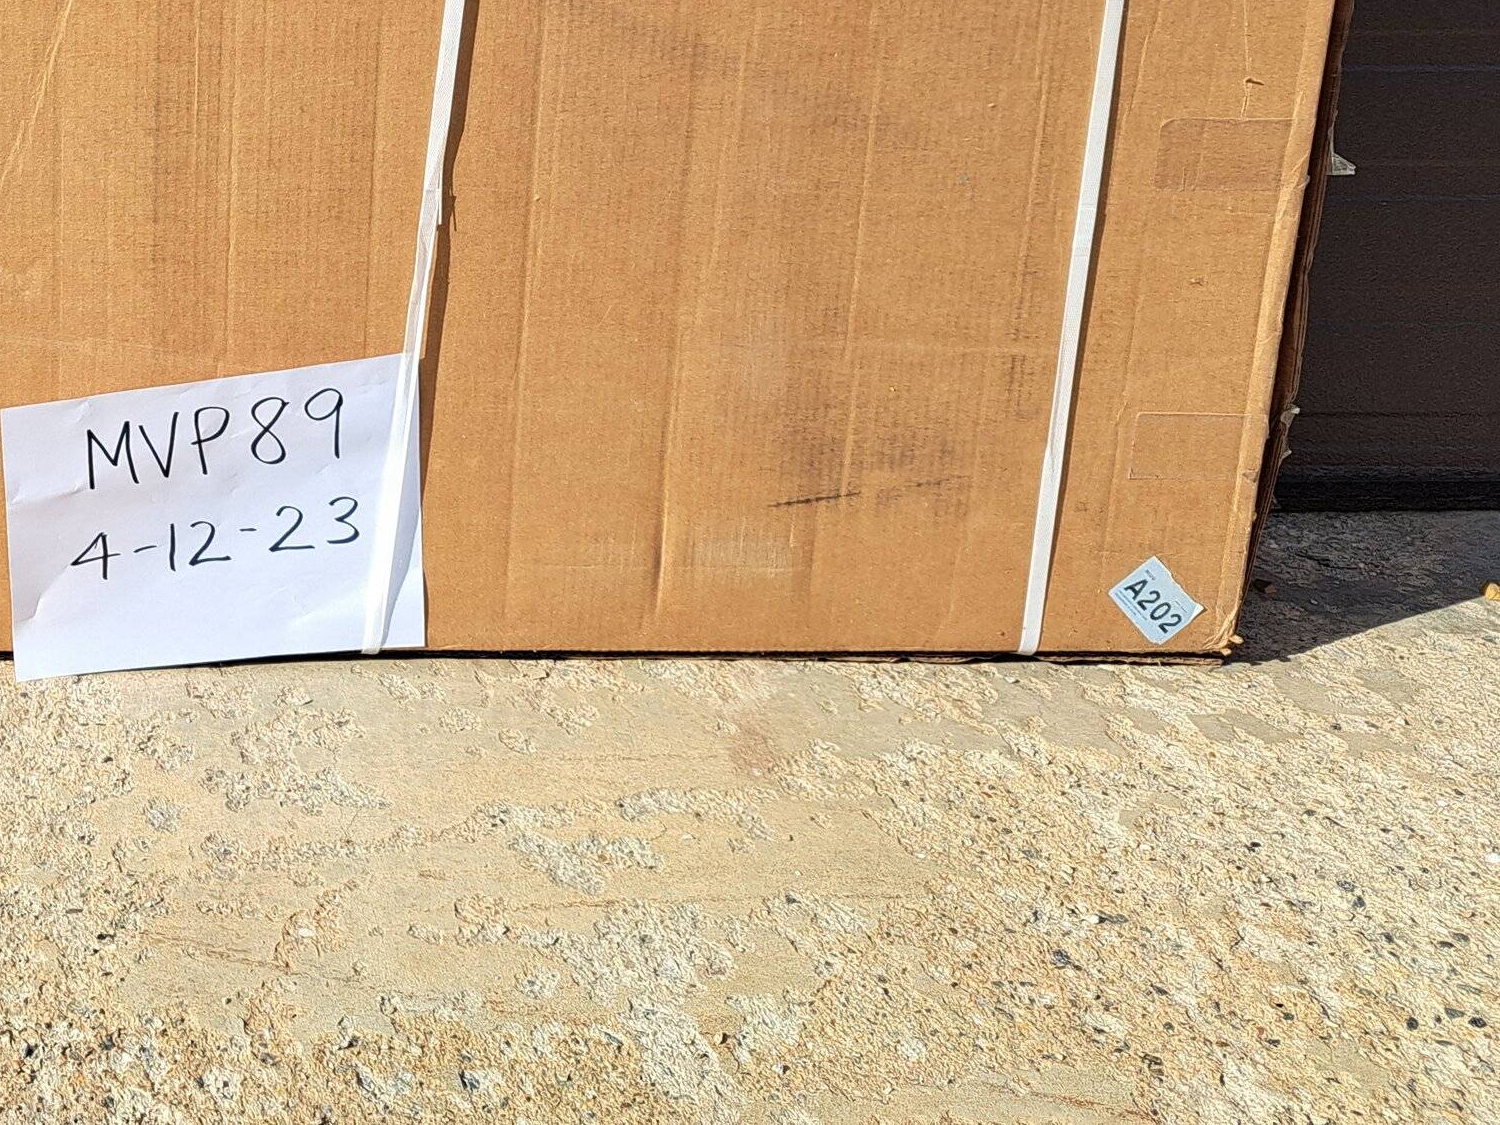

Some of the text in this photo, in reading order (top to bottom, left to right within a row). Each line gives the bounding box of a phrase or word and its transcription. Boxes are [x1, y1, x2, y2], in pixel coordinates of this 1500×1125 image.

[86, 387, 344, 490] MVP89
[70, 496, 360, 580] 4-12-23
[1123, 579, 1182, 634] A202
